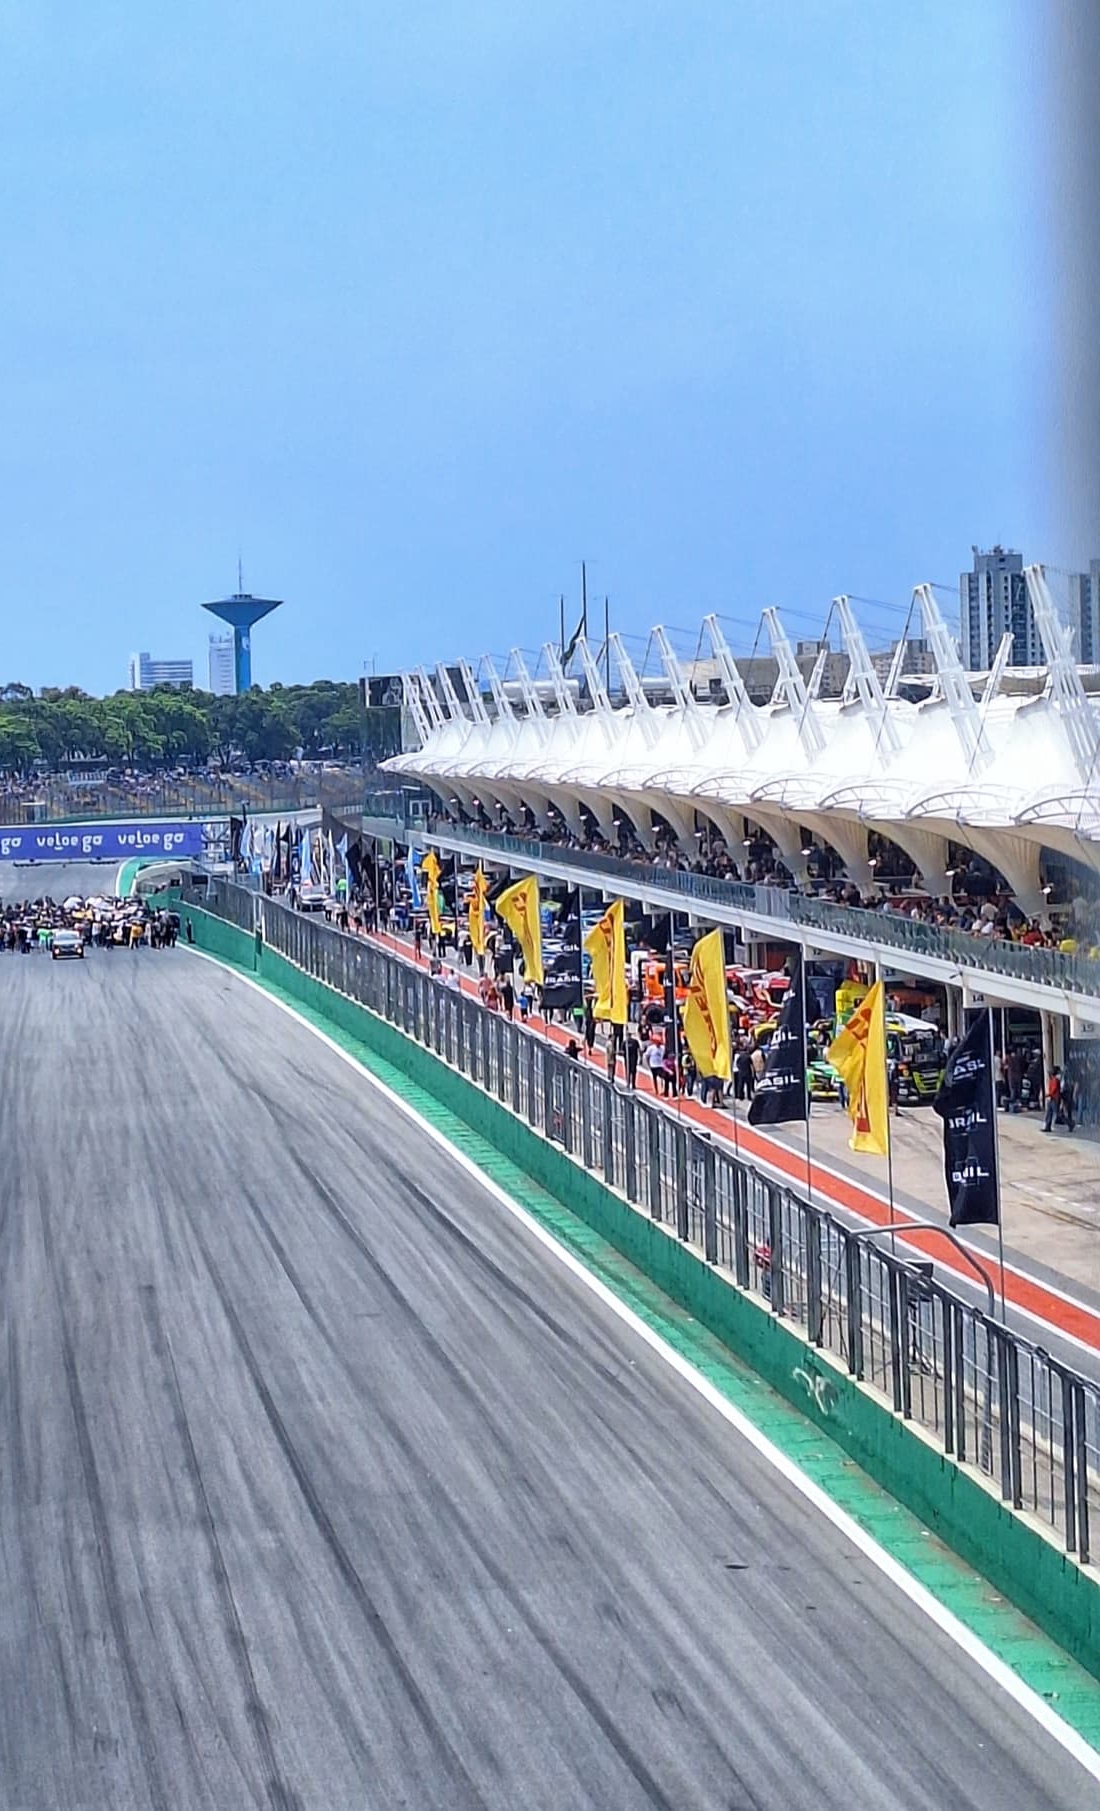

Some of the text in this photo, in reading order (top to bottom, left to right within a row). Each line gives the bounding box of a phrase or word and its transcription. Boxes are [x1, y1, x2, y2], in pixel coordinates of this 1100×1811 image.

[1, 838, 22, 855] go
[36, 832, 78, 850] veloe
[82, 835, 103, 853] go
[118, 830, 160, 848] veloe
[163, 833, 184, 851] go
